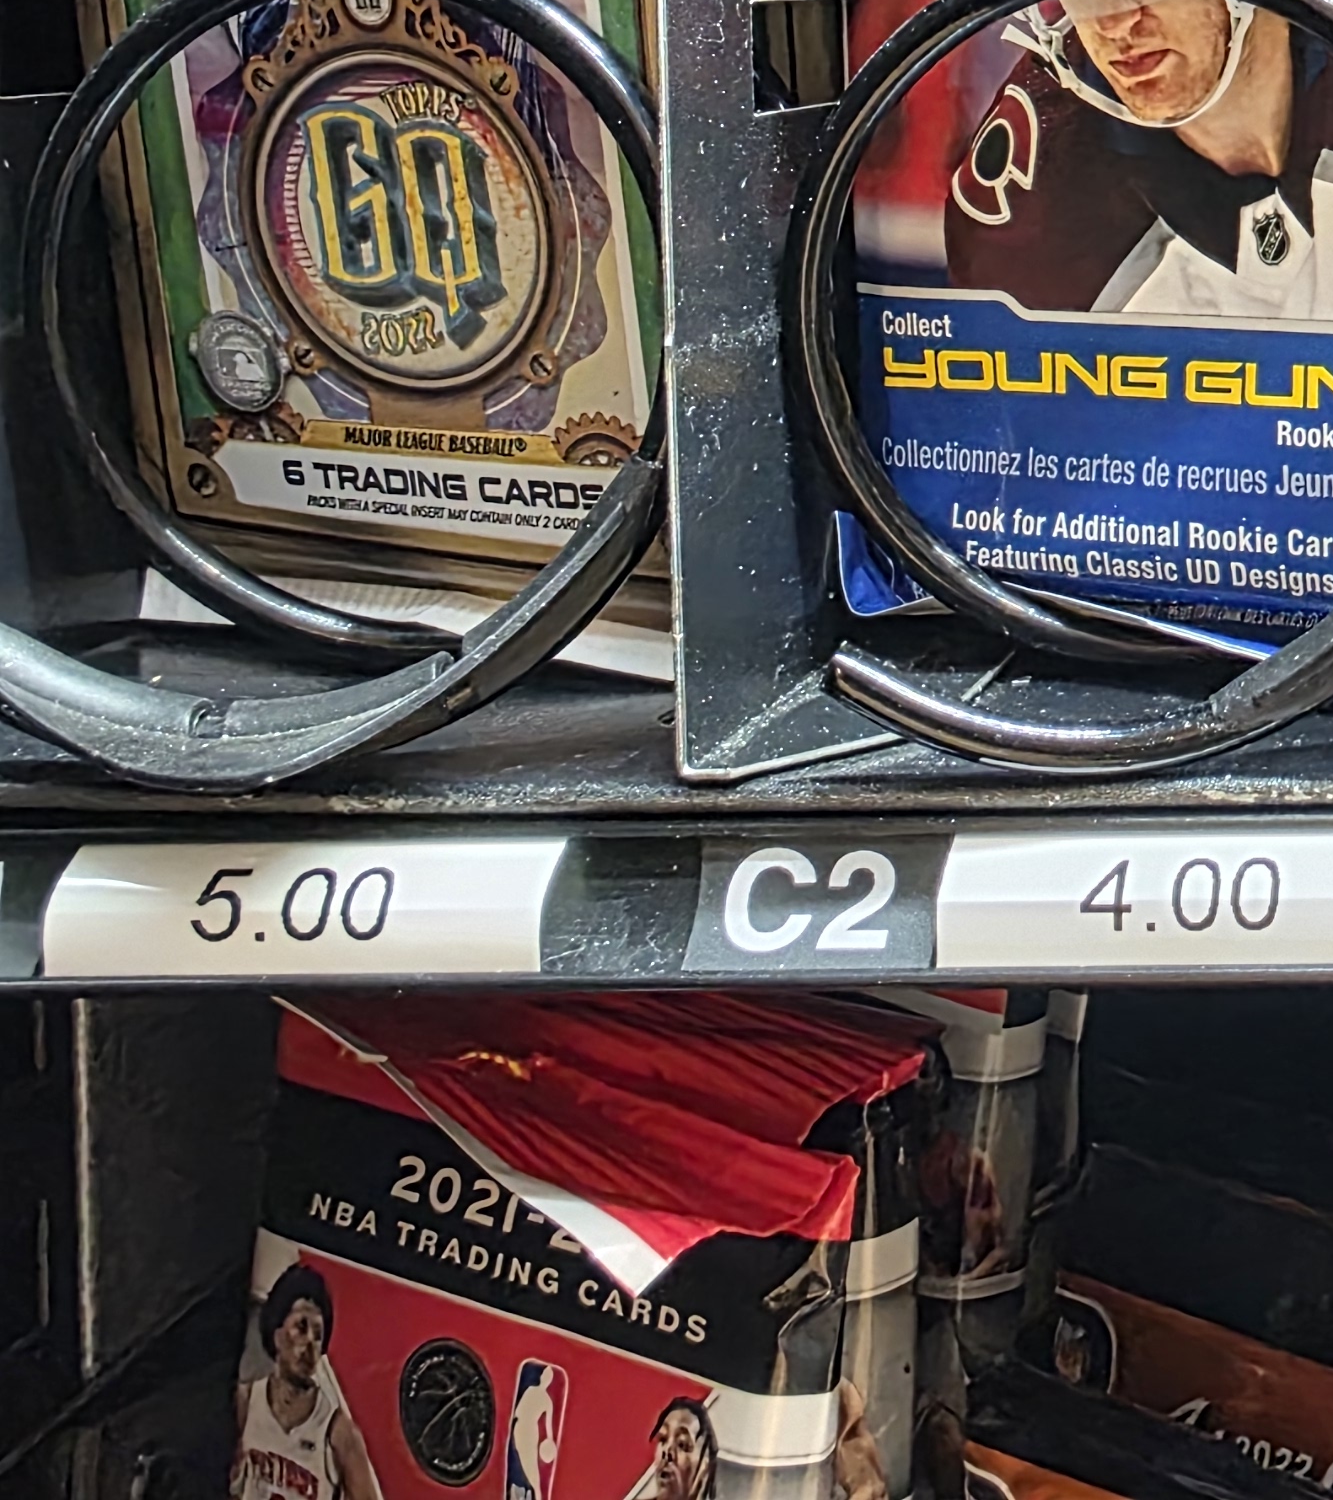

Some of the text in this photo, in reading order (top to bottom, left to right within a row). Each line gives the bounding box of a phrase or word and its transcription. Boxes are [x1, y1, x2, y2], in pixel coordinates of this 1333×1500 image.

[882, 310, 952, 338] Collect
[883, 347, 1168, 399] YOUNG
[344, 426, 392, 447] MAJOR
[396, 429, 447, 452] LEAGUE
[282, 459, 604, 510] 6 TRADING CARDS
[882, 436, 1021, 476] Collectionnez
[1028, 447, 1058, 479] les
[1065, 454, 1135, 485] cartes
[1142, 456, 1170, 488] de
[1177, 464, 1267, 495] recrues
[553, 516, 582, 531] CARD
[952, 503, 1005, 534] Look
[1012, 508, 1047, 537] for
[1053, 512, 1179, 548] Additional
[1188, 522, 1278, 554] Rookie
[965, 540, 1078, 579] Featuring
[1086, 550, 1178, 582] Classic
[1186, 558, 1221, 585] UD
[189, 867, 396, 944] 5.00
[722, 848, 895, 955] C2
[1081, 859, 1282, 933] 4.00
[309, 1192, 709, 1344] NBA TRADING CARDS
